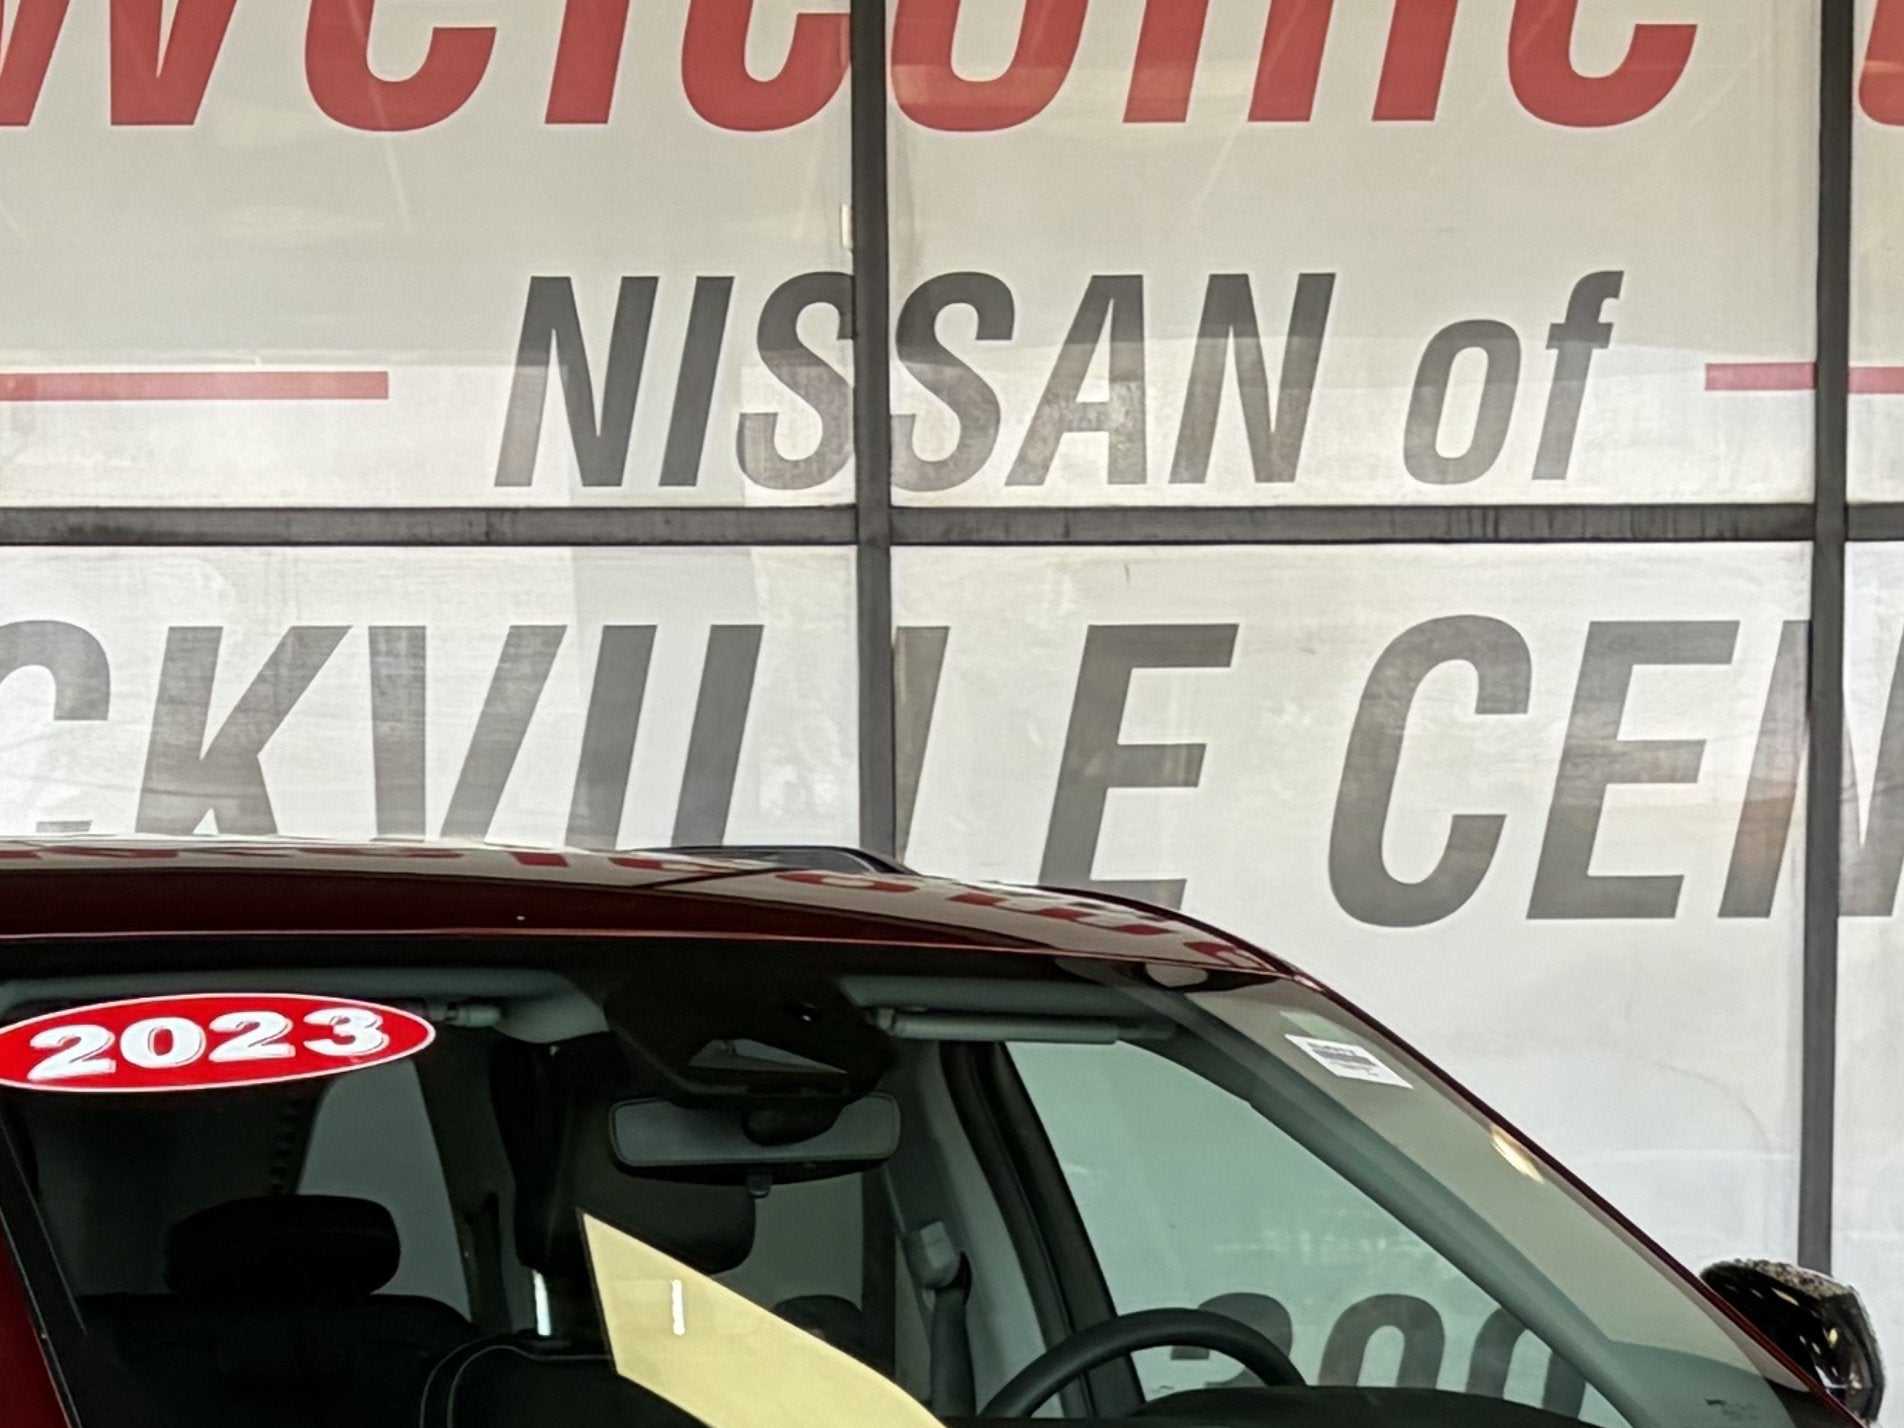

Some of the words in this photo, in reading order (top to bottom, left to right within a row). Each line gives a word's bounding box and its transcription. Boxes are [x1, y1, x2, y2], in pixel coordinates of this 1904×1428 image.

[493, 271, 1337, 491] NISSAN
[1401, 270, 1624, 489] of
[26, 1007, 391, 1081] 2023
